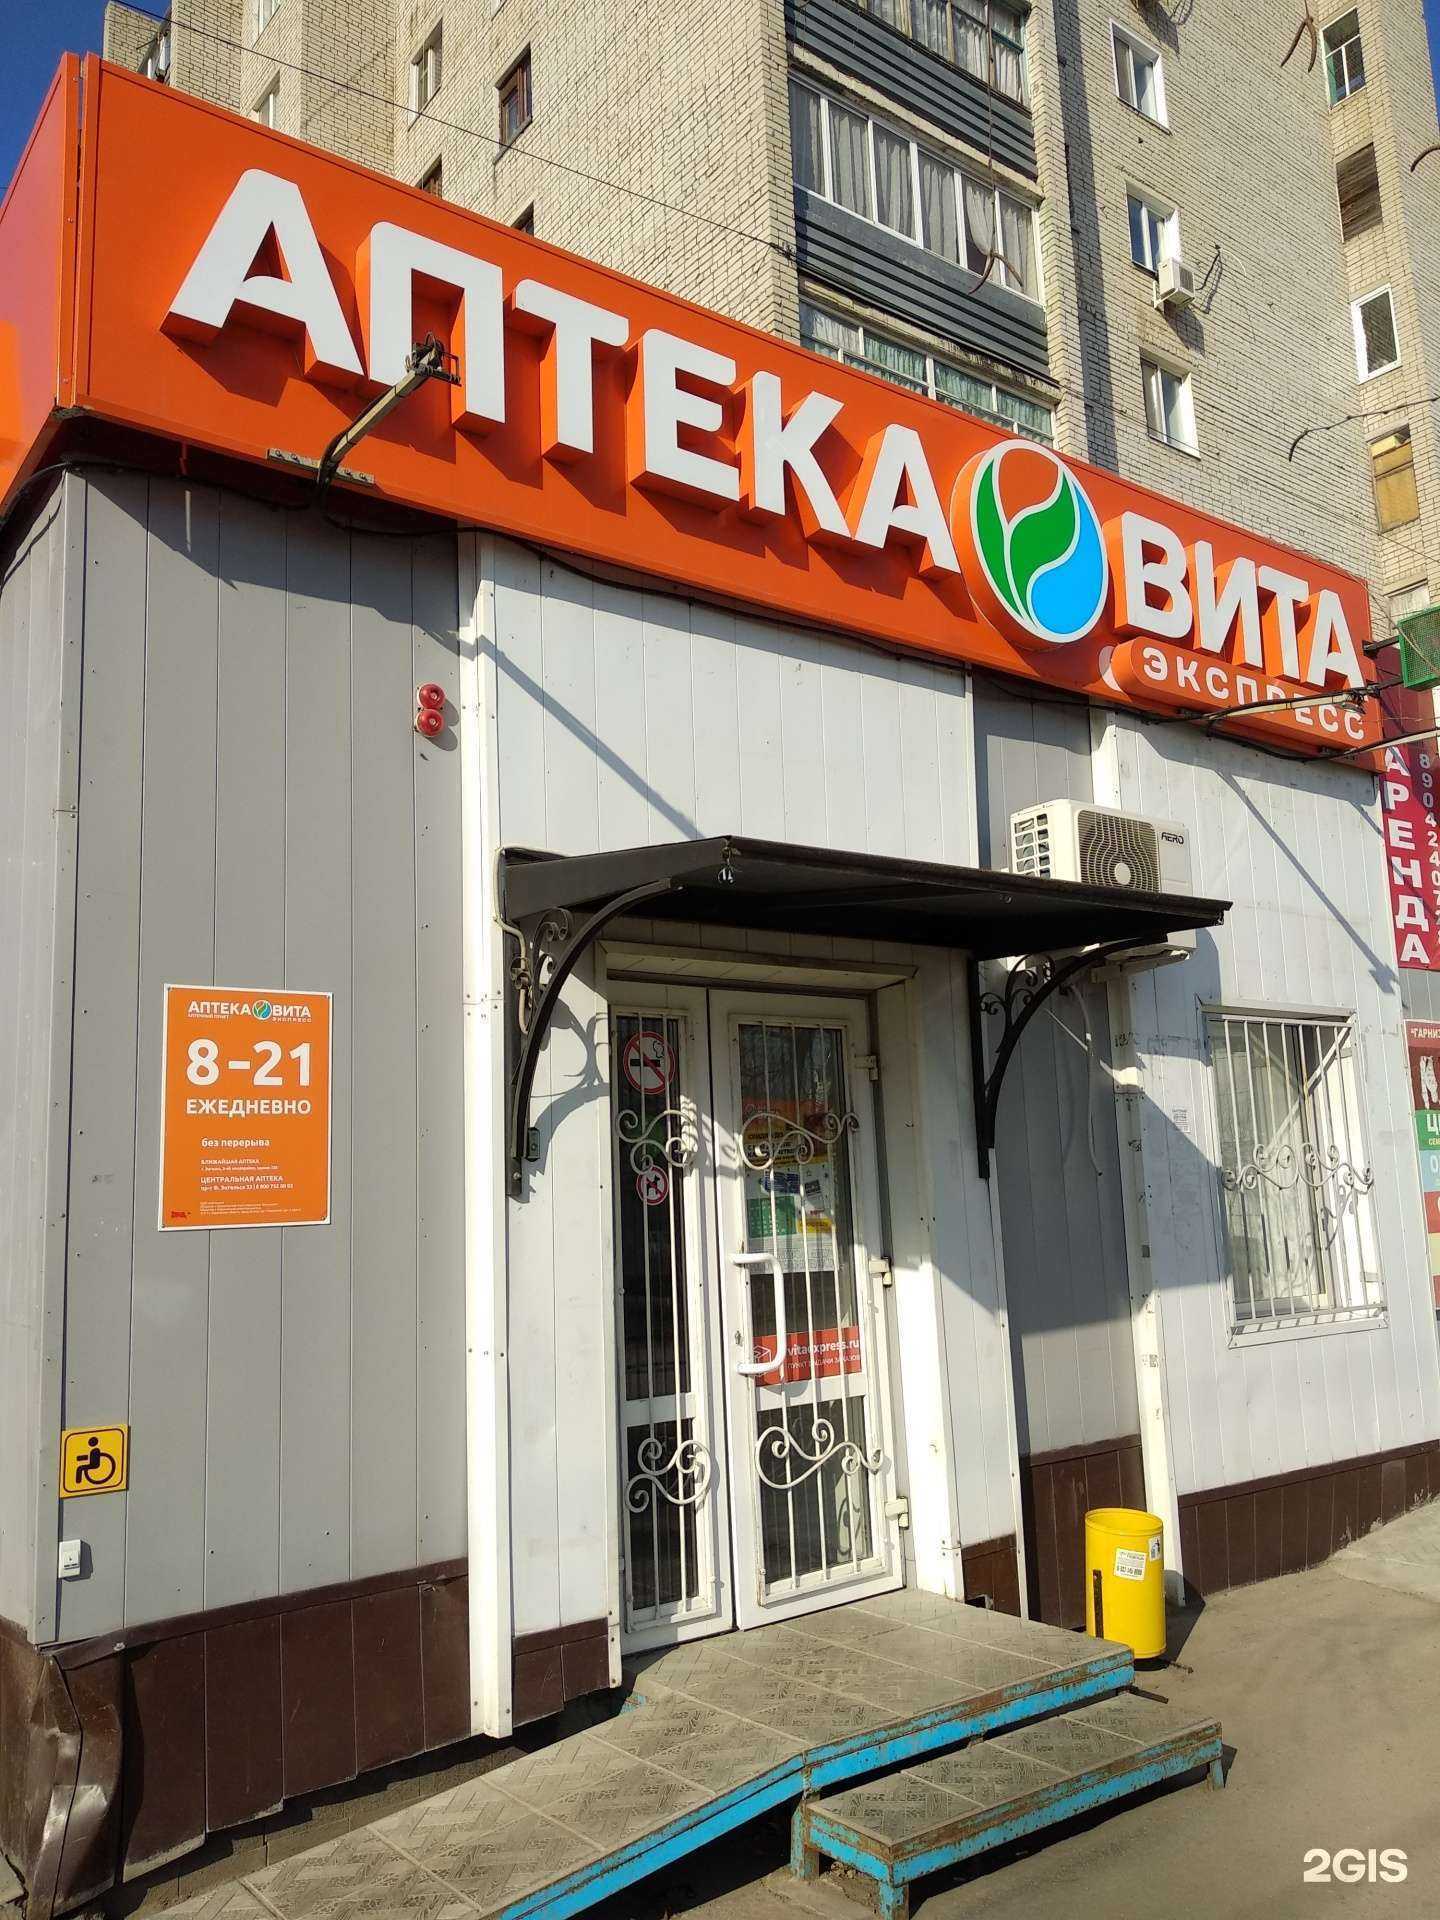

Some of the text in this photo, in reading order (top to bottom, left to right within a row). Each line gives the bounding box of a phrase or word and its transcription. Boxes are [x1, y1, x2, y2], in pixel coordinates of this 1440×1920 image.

[167, 167, 1368, 698] АПТЕКА ВИТА
[1160, 831, 1185, 845] AERO
[1384, 745, 1431, 965] АРЕНДА
[187, 1000, 311, 1018] АПТЕКА ВИТА
[186, 1098, 311, 1118] ЕЖЕДНЕВНО
[201, 1138, 270, 1149] без перерыва
[201, 1175, 284, 1185] ЦЕНТРАЛЬНАЯ АПТЕКА
